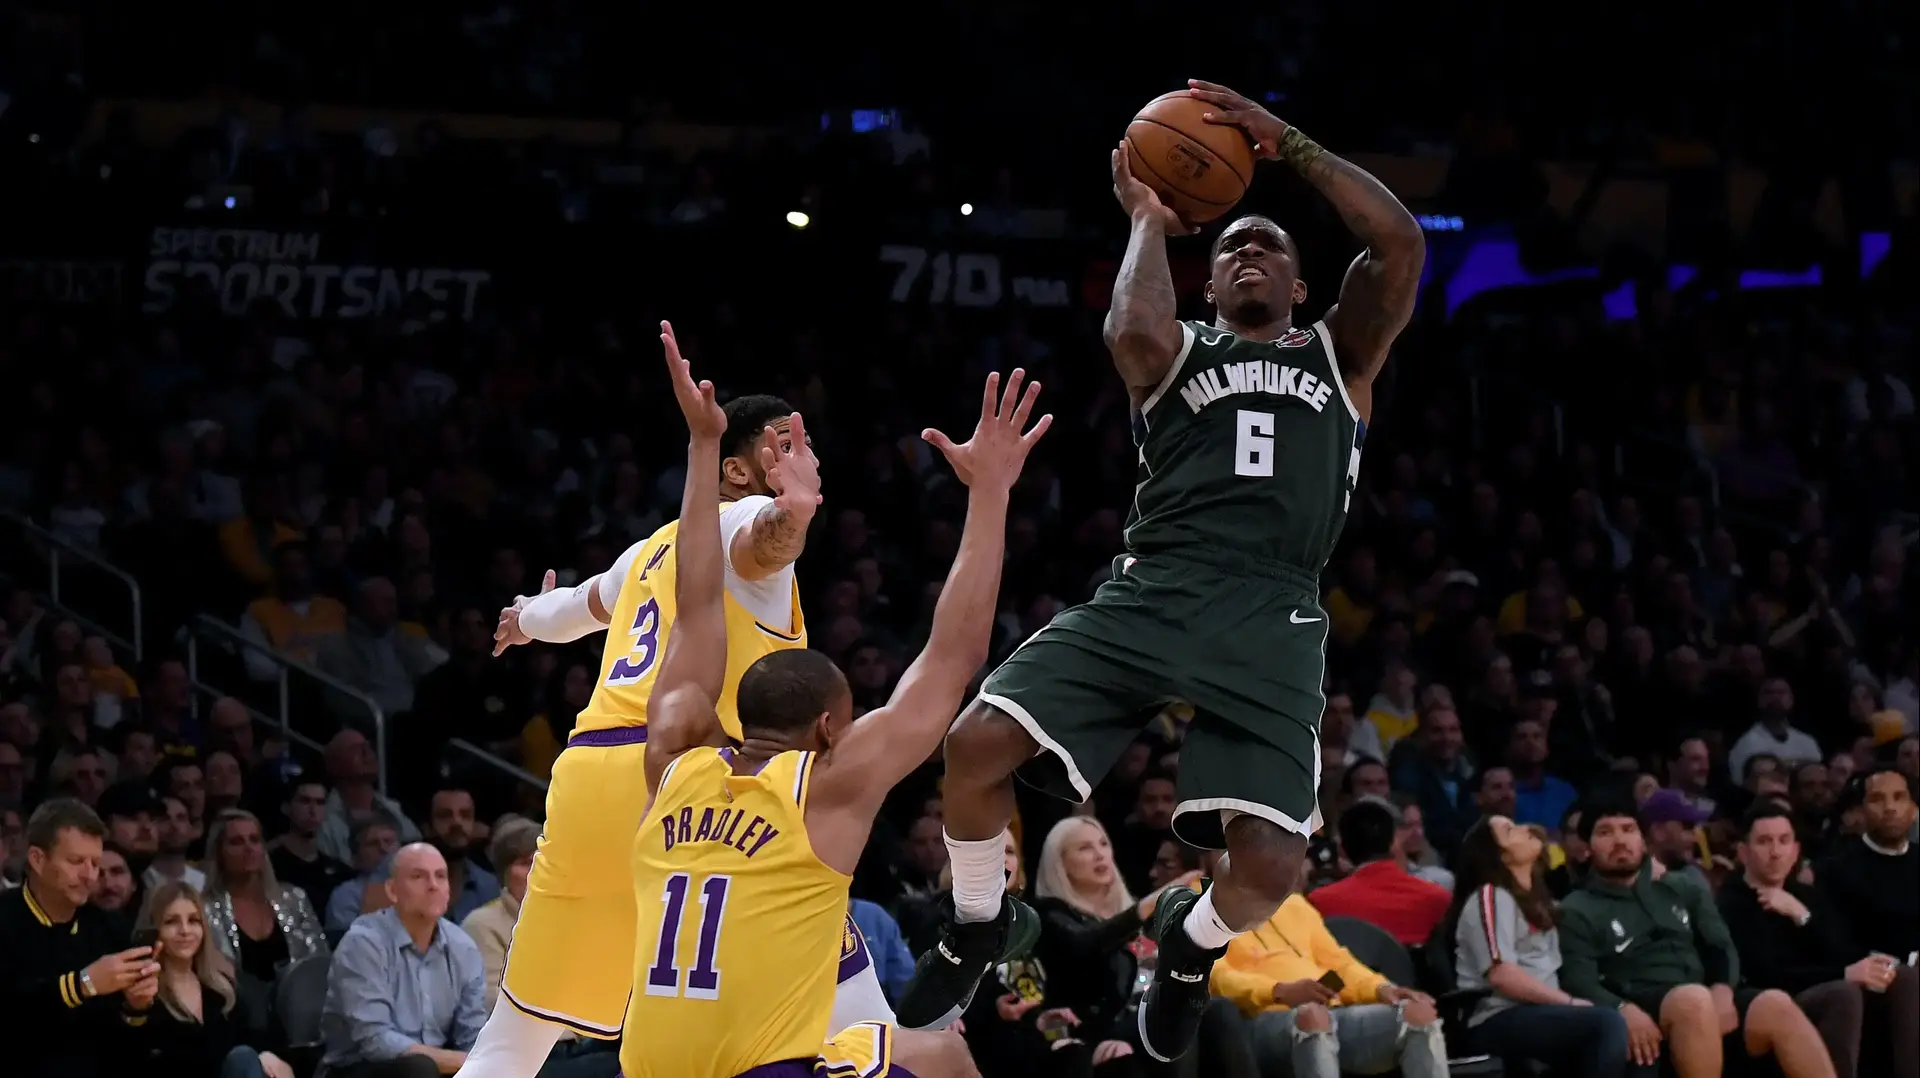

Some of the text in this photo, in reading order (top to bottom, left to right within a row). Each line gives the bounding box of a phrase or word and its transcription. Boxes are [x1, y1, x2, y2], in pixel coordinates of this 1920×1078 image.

[151, 227, 321, 260] SPECTRUM
[880, 244, 1001, 306] 710
[1180, 360, 1333, 415] MILWAUKEE
[1235, 408, 1275, 477] 6
[604, 597, 660, 687] 3
[661, 806, 779, 858] BRADLEY
[645, 872, 732, 1001] 11
